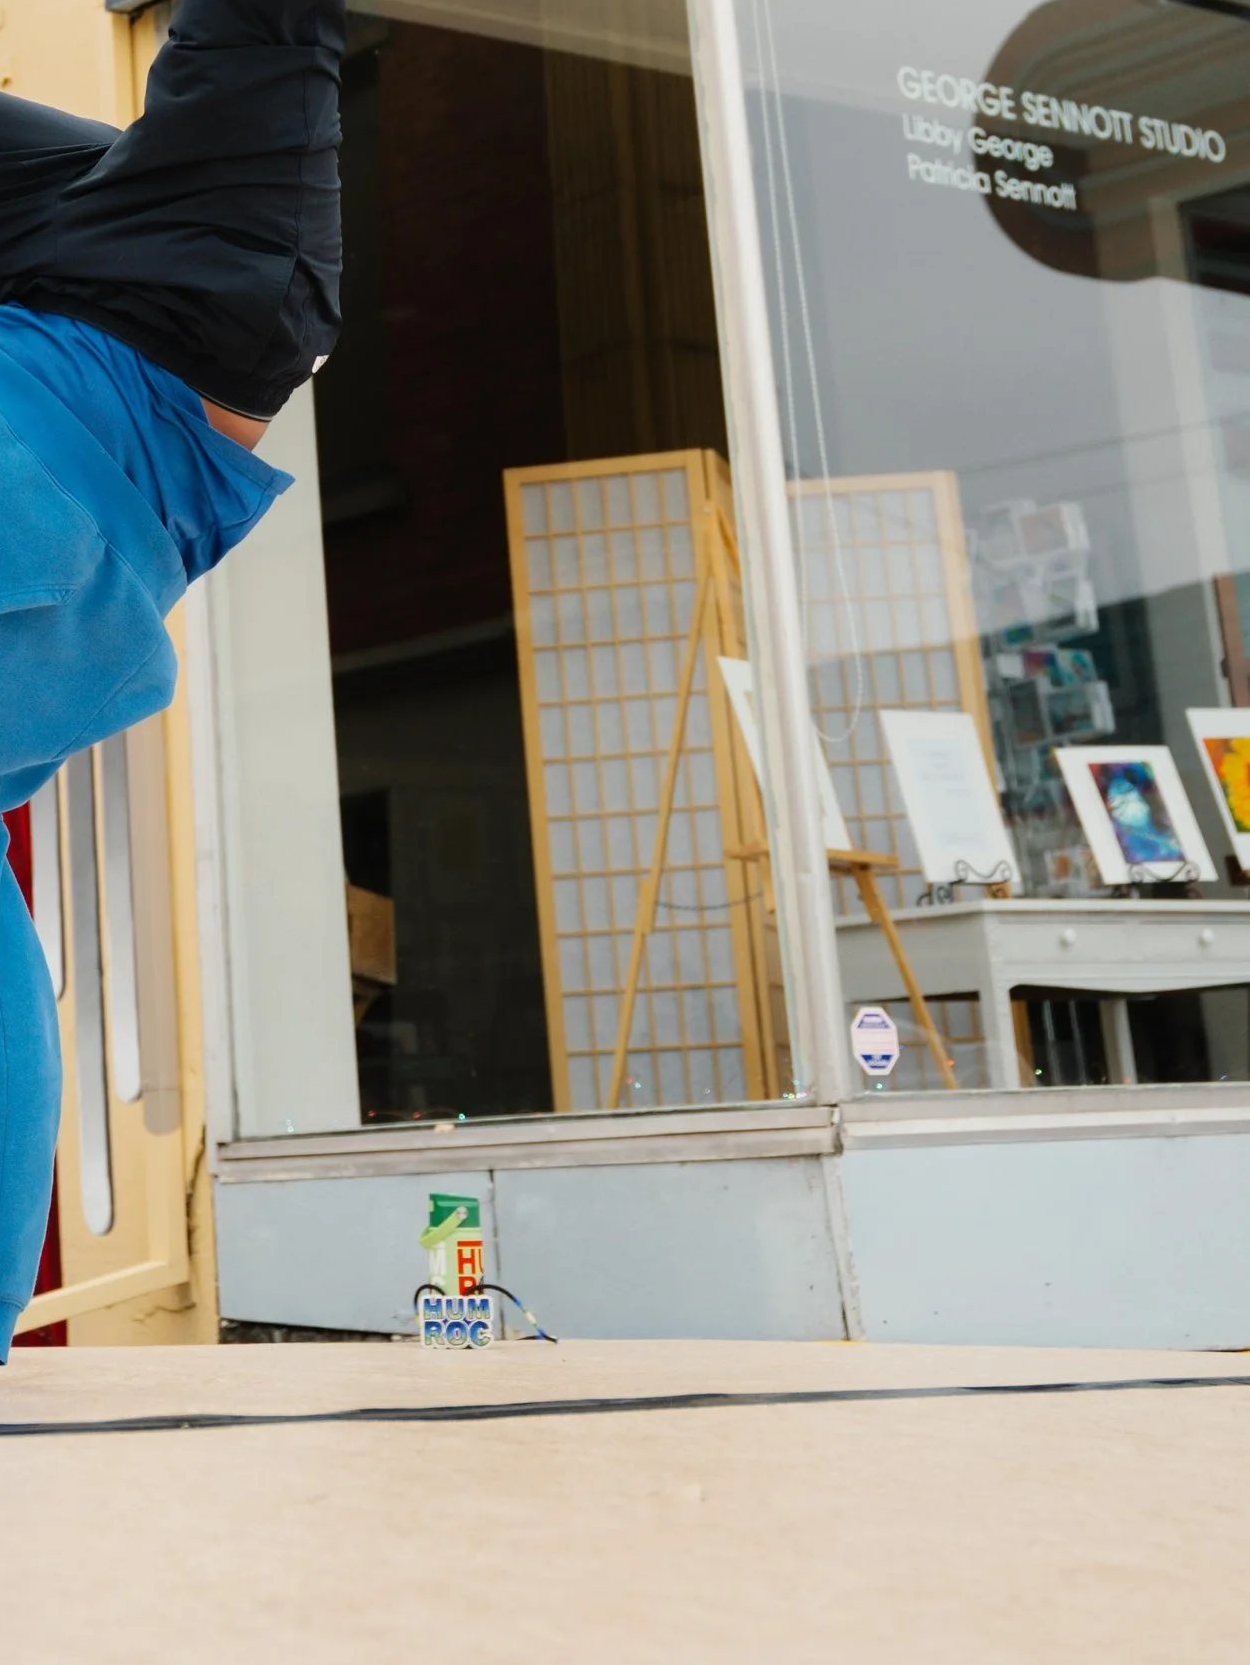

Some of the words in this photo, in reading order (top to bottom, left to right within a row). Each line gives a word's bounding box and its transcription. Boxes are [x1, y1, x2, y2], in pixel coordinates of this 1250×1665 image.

[897, 66, 1017, 120] GEORGE
[1021, 91, 1133, 144] SENNOTT
[1138, 116, 1226, 163] STUDIO
[902, 113, 964, 155] Libby
[967, 127, 1054, 171] George
[907, 152, 992, 195] Patricia
[994, 170, 1077, 211] Sennott
[423, 1298, 491, 1320] HUM
[424, 1320, 491, 1347] ROC
